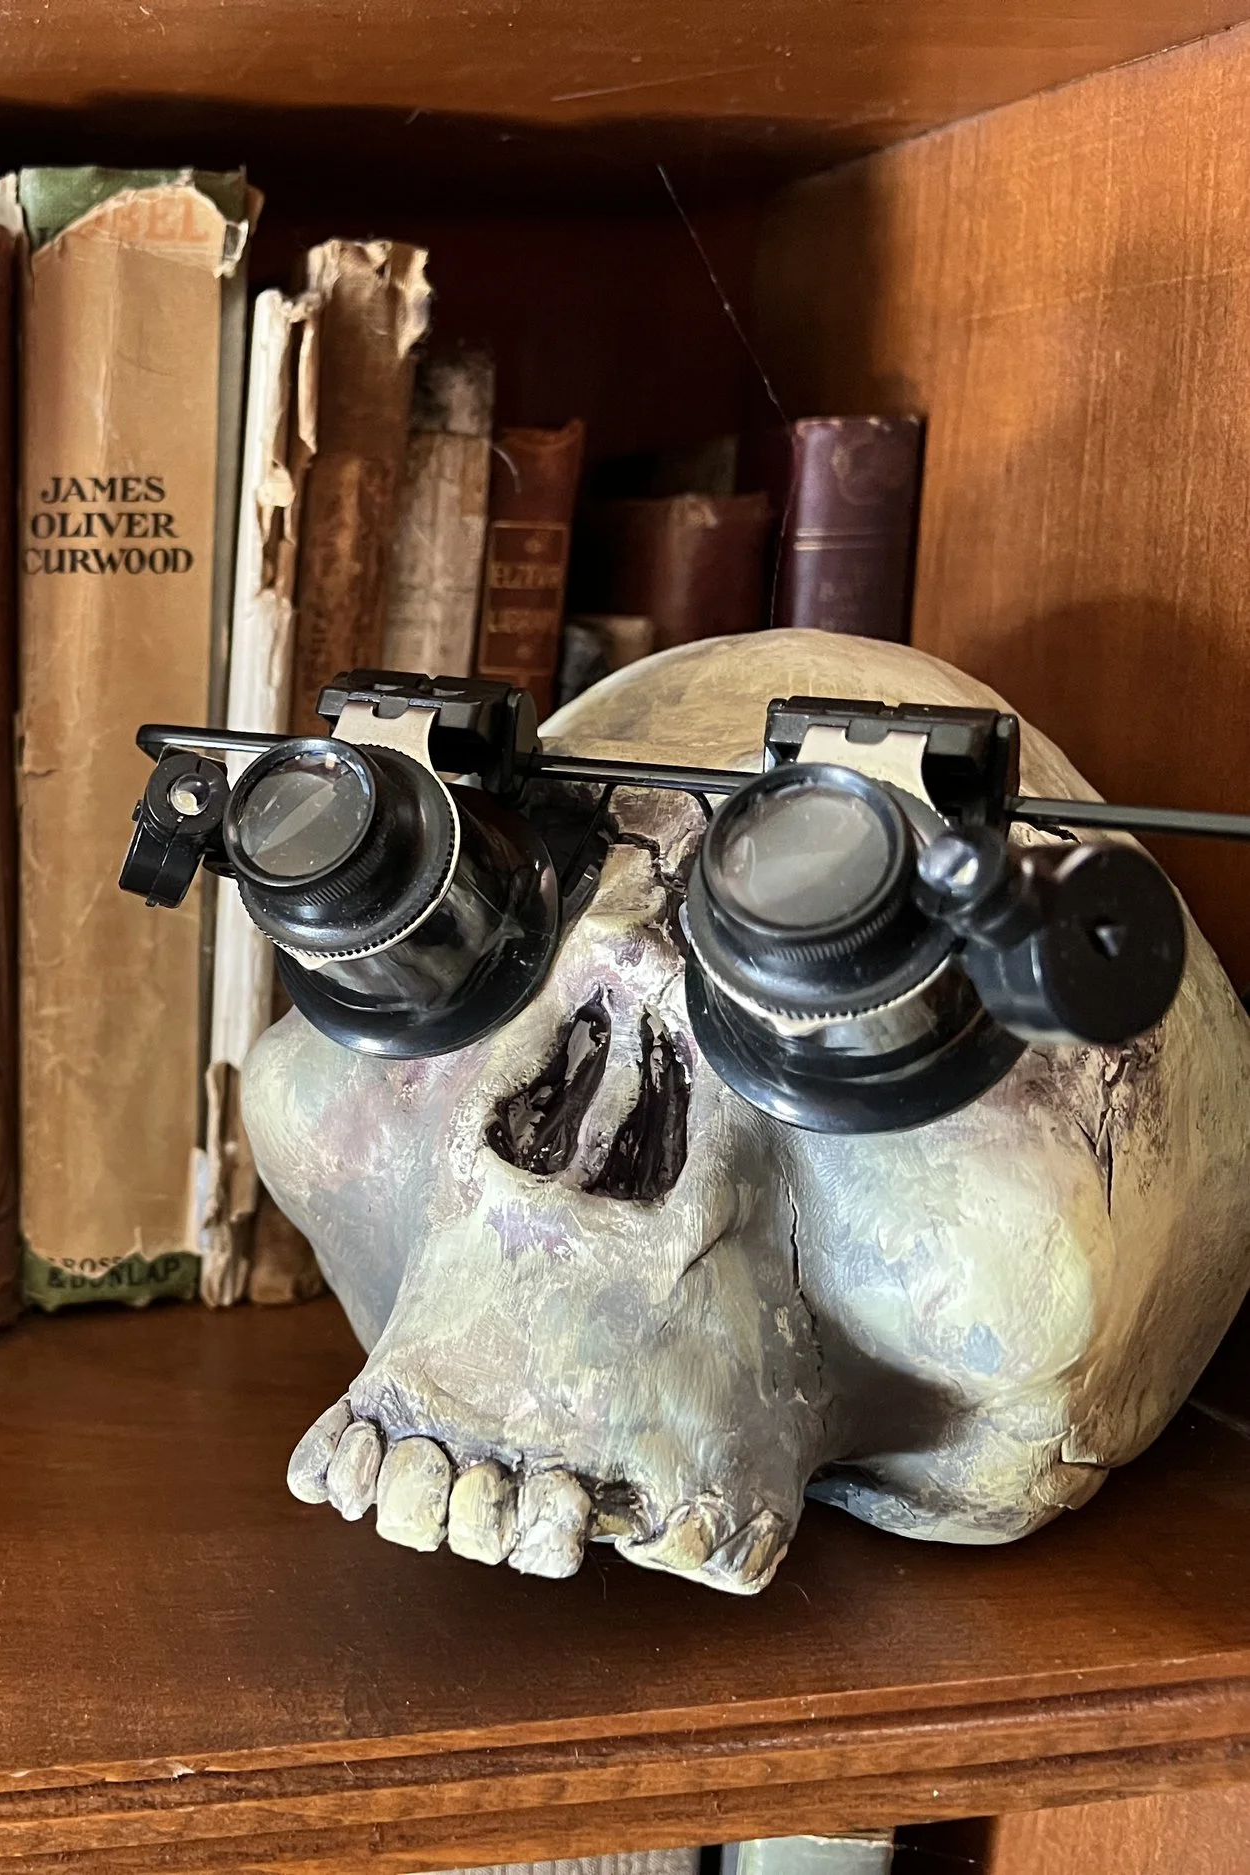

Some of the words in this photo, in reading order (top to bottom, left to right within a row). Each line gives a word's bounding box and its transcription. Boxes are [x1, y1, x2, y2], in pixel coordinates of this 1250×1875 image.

[40, 474, 166, 505] JAMES
[30, 510, 181, 540] OLIVER
[21, 547, 195, 575] CURWOOD
